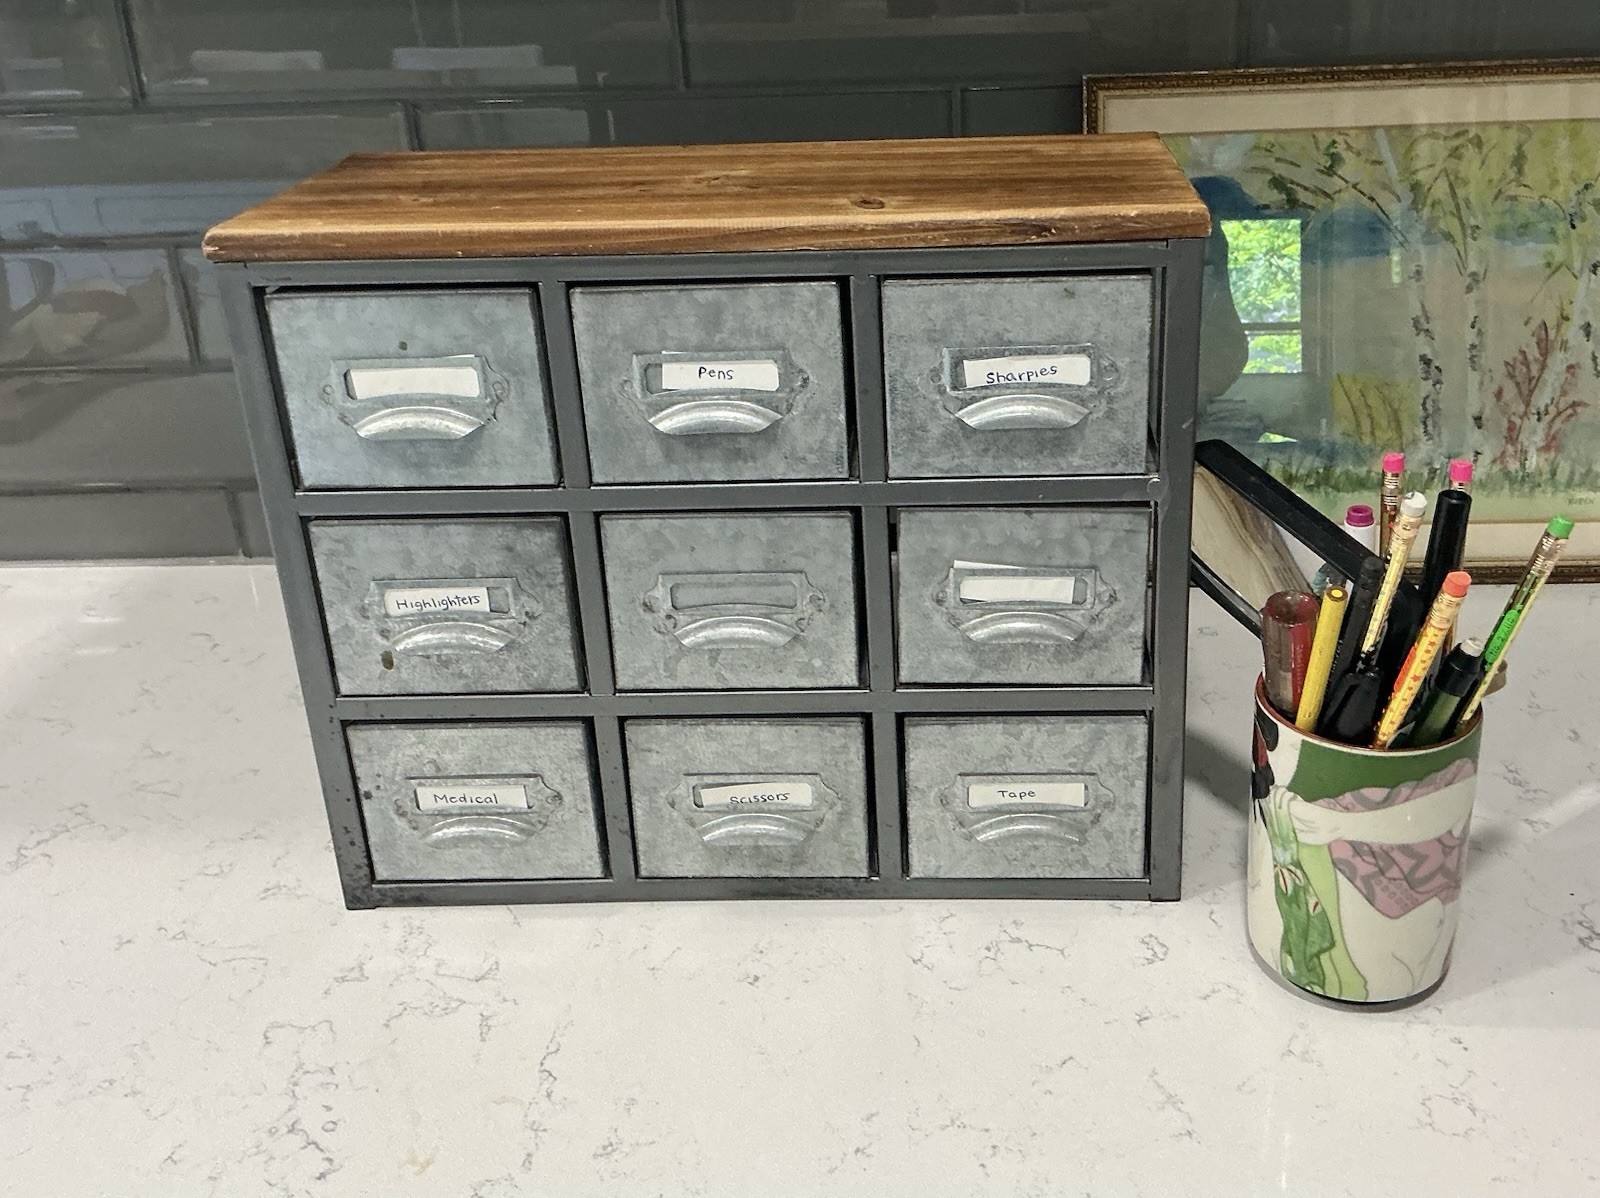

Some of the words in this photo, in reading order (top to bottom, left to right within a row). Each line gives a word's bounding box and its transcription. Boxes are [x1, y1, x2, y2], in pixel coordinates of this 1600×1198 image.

[698, 366, 734, 380] Pens
[986, 365, 1058, 384] Sharpies
[396, 595, 480, 611] Highlighters
[433, 793, 498, 804] Medical
[730, 792, 790, 804] Scissors
[997, 790, 1036, 800] Tape
